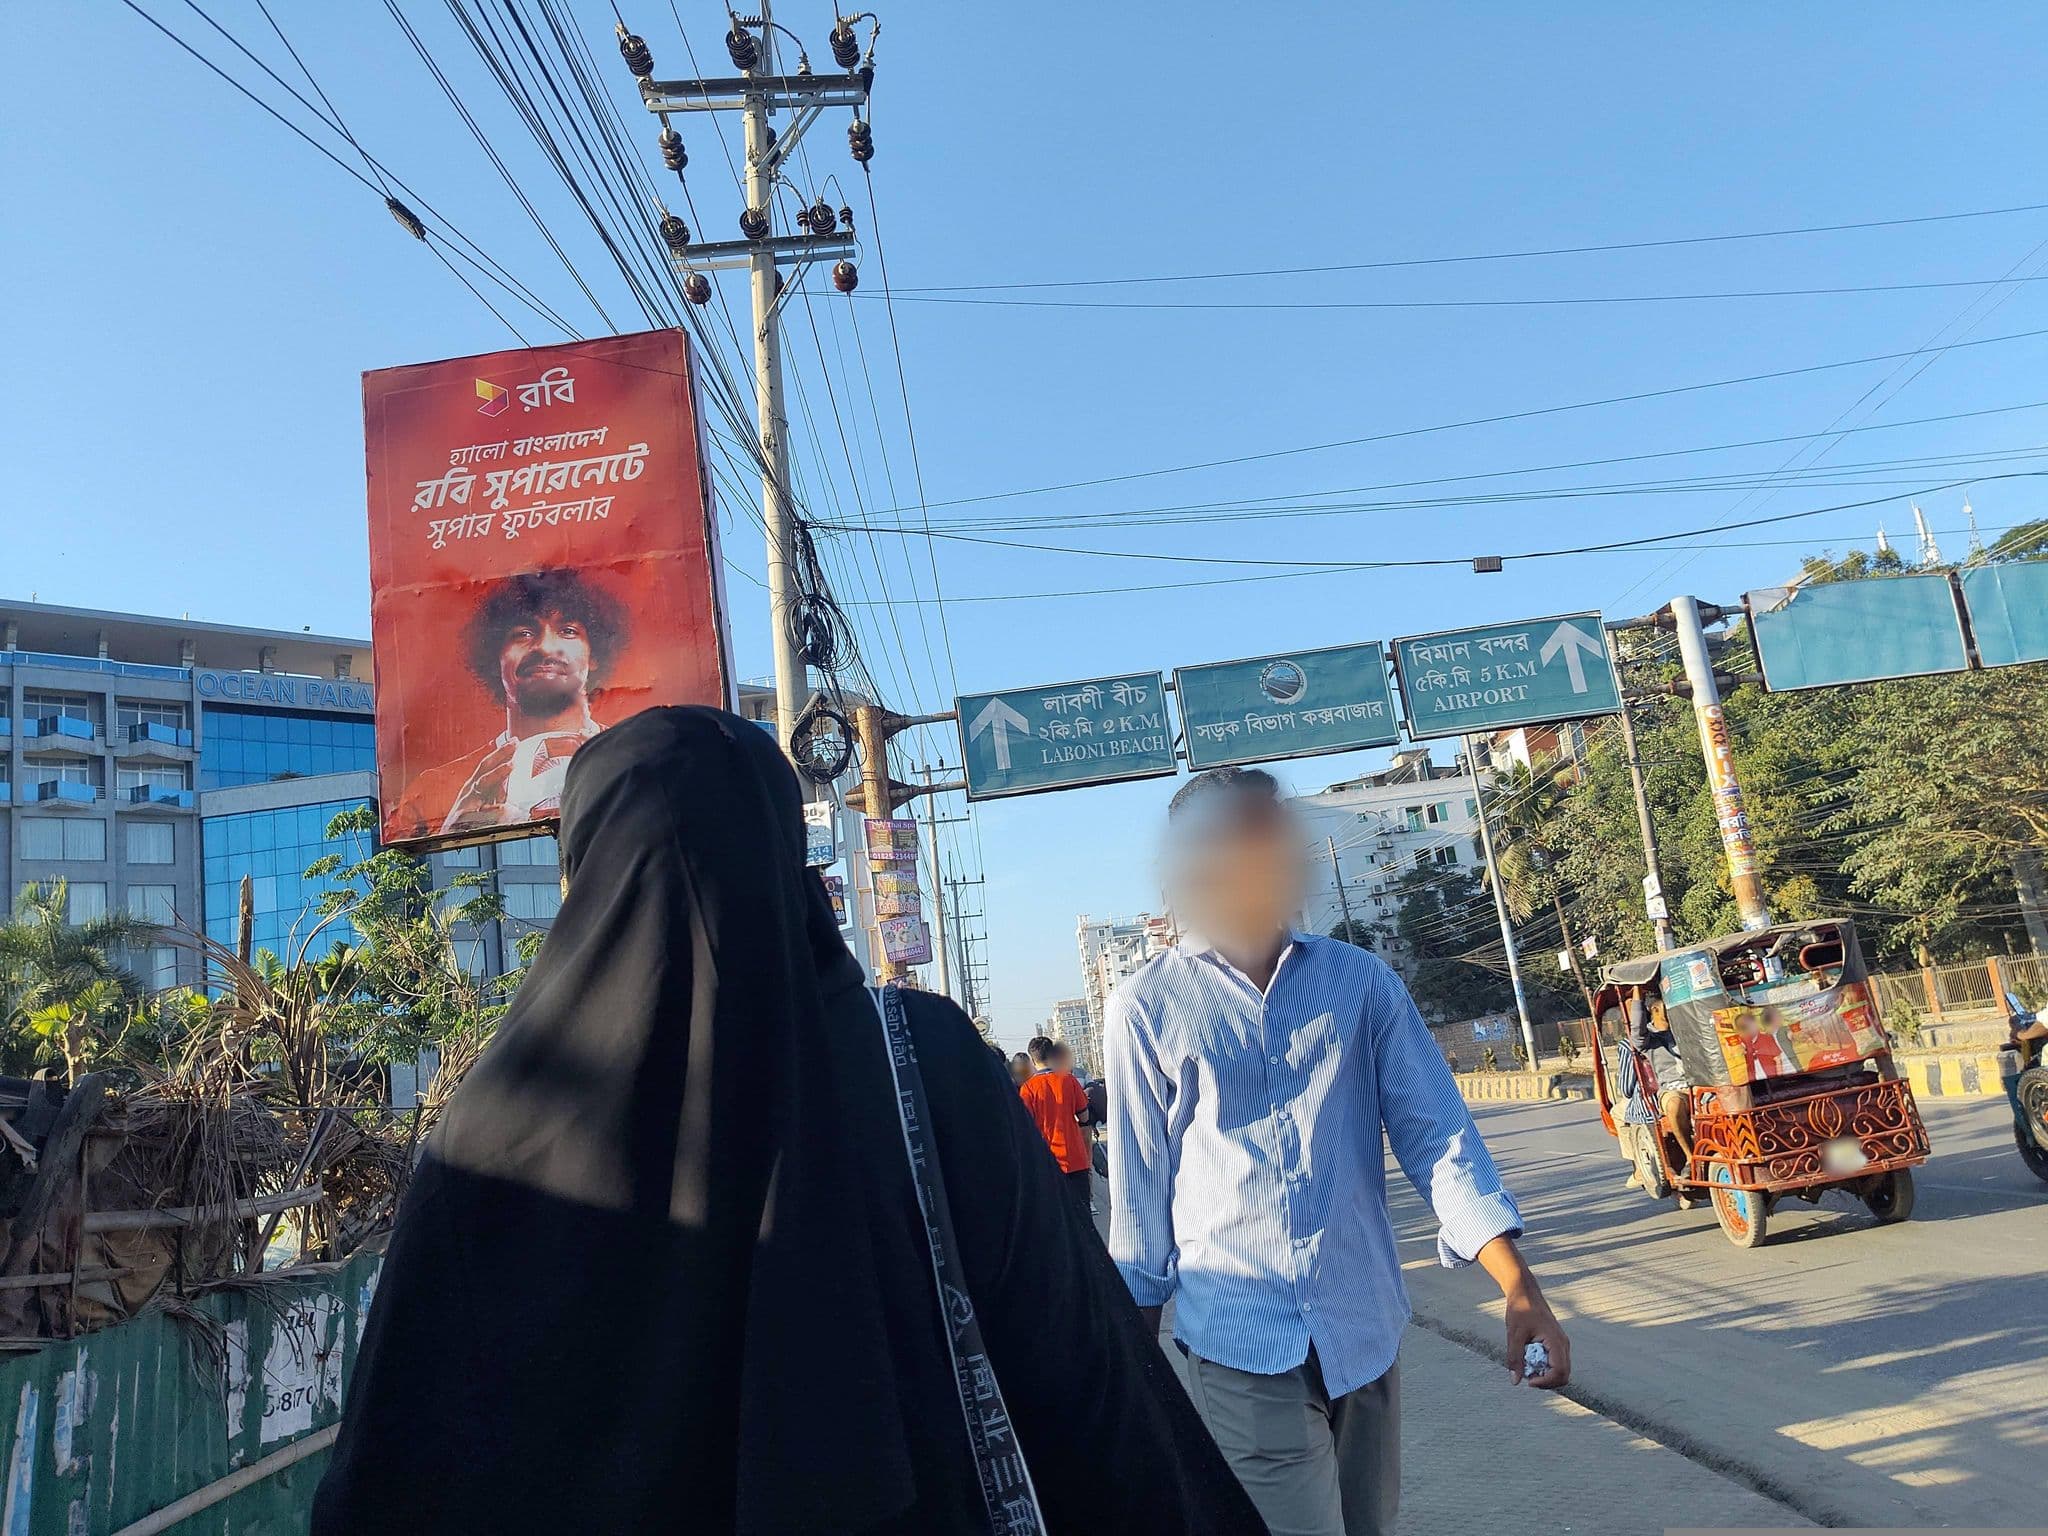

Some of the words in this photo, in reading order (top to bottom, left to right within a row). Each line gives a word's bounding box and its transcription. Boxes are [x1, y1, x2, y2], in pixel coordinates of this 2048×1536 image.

[516, 367, 575, 412] রবি
[449, 440, 509, 467] হ্যালো
[513, 426, 609, 457] বাংলাদেশ
[410, 467, 477, 512] রবি
[483, 443, 651, 510] সুপারনেটে
[426, 513, 496, 550] সুপার
[500, 495, 616, 541] ফুটবলার
[1408, 640, 1471, 666] বিমান
[1475, 632, 1530, 656] বন্দর
[1480, 666, 1491, 683] 5
[1495, 660, 1538, 681] K.M
[197, 673, 296, 703] OCEAN
[306, 682, 375, 710] PARA
[1040, 685, 1105, 715] লাবণী
[1110, 681, 1149, 707] বীচ
[1433, 684, 1529, 713] AIRPORT
[1103, 719, 1115, 734] 2
[1119, 712, 1161, 733] K.M
[1195, 720, 1240, 742] সড়ক
[1244, 712, 1296, 735] বিভাগ
[1300, 700, 1385, 726] কক্সবাজার
[1041, 742, 1106, 764] LABONI
[1109, 735, 1166, 756] BEACH
